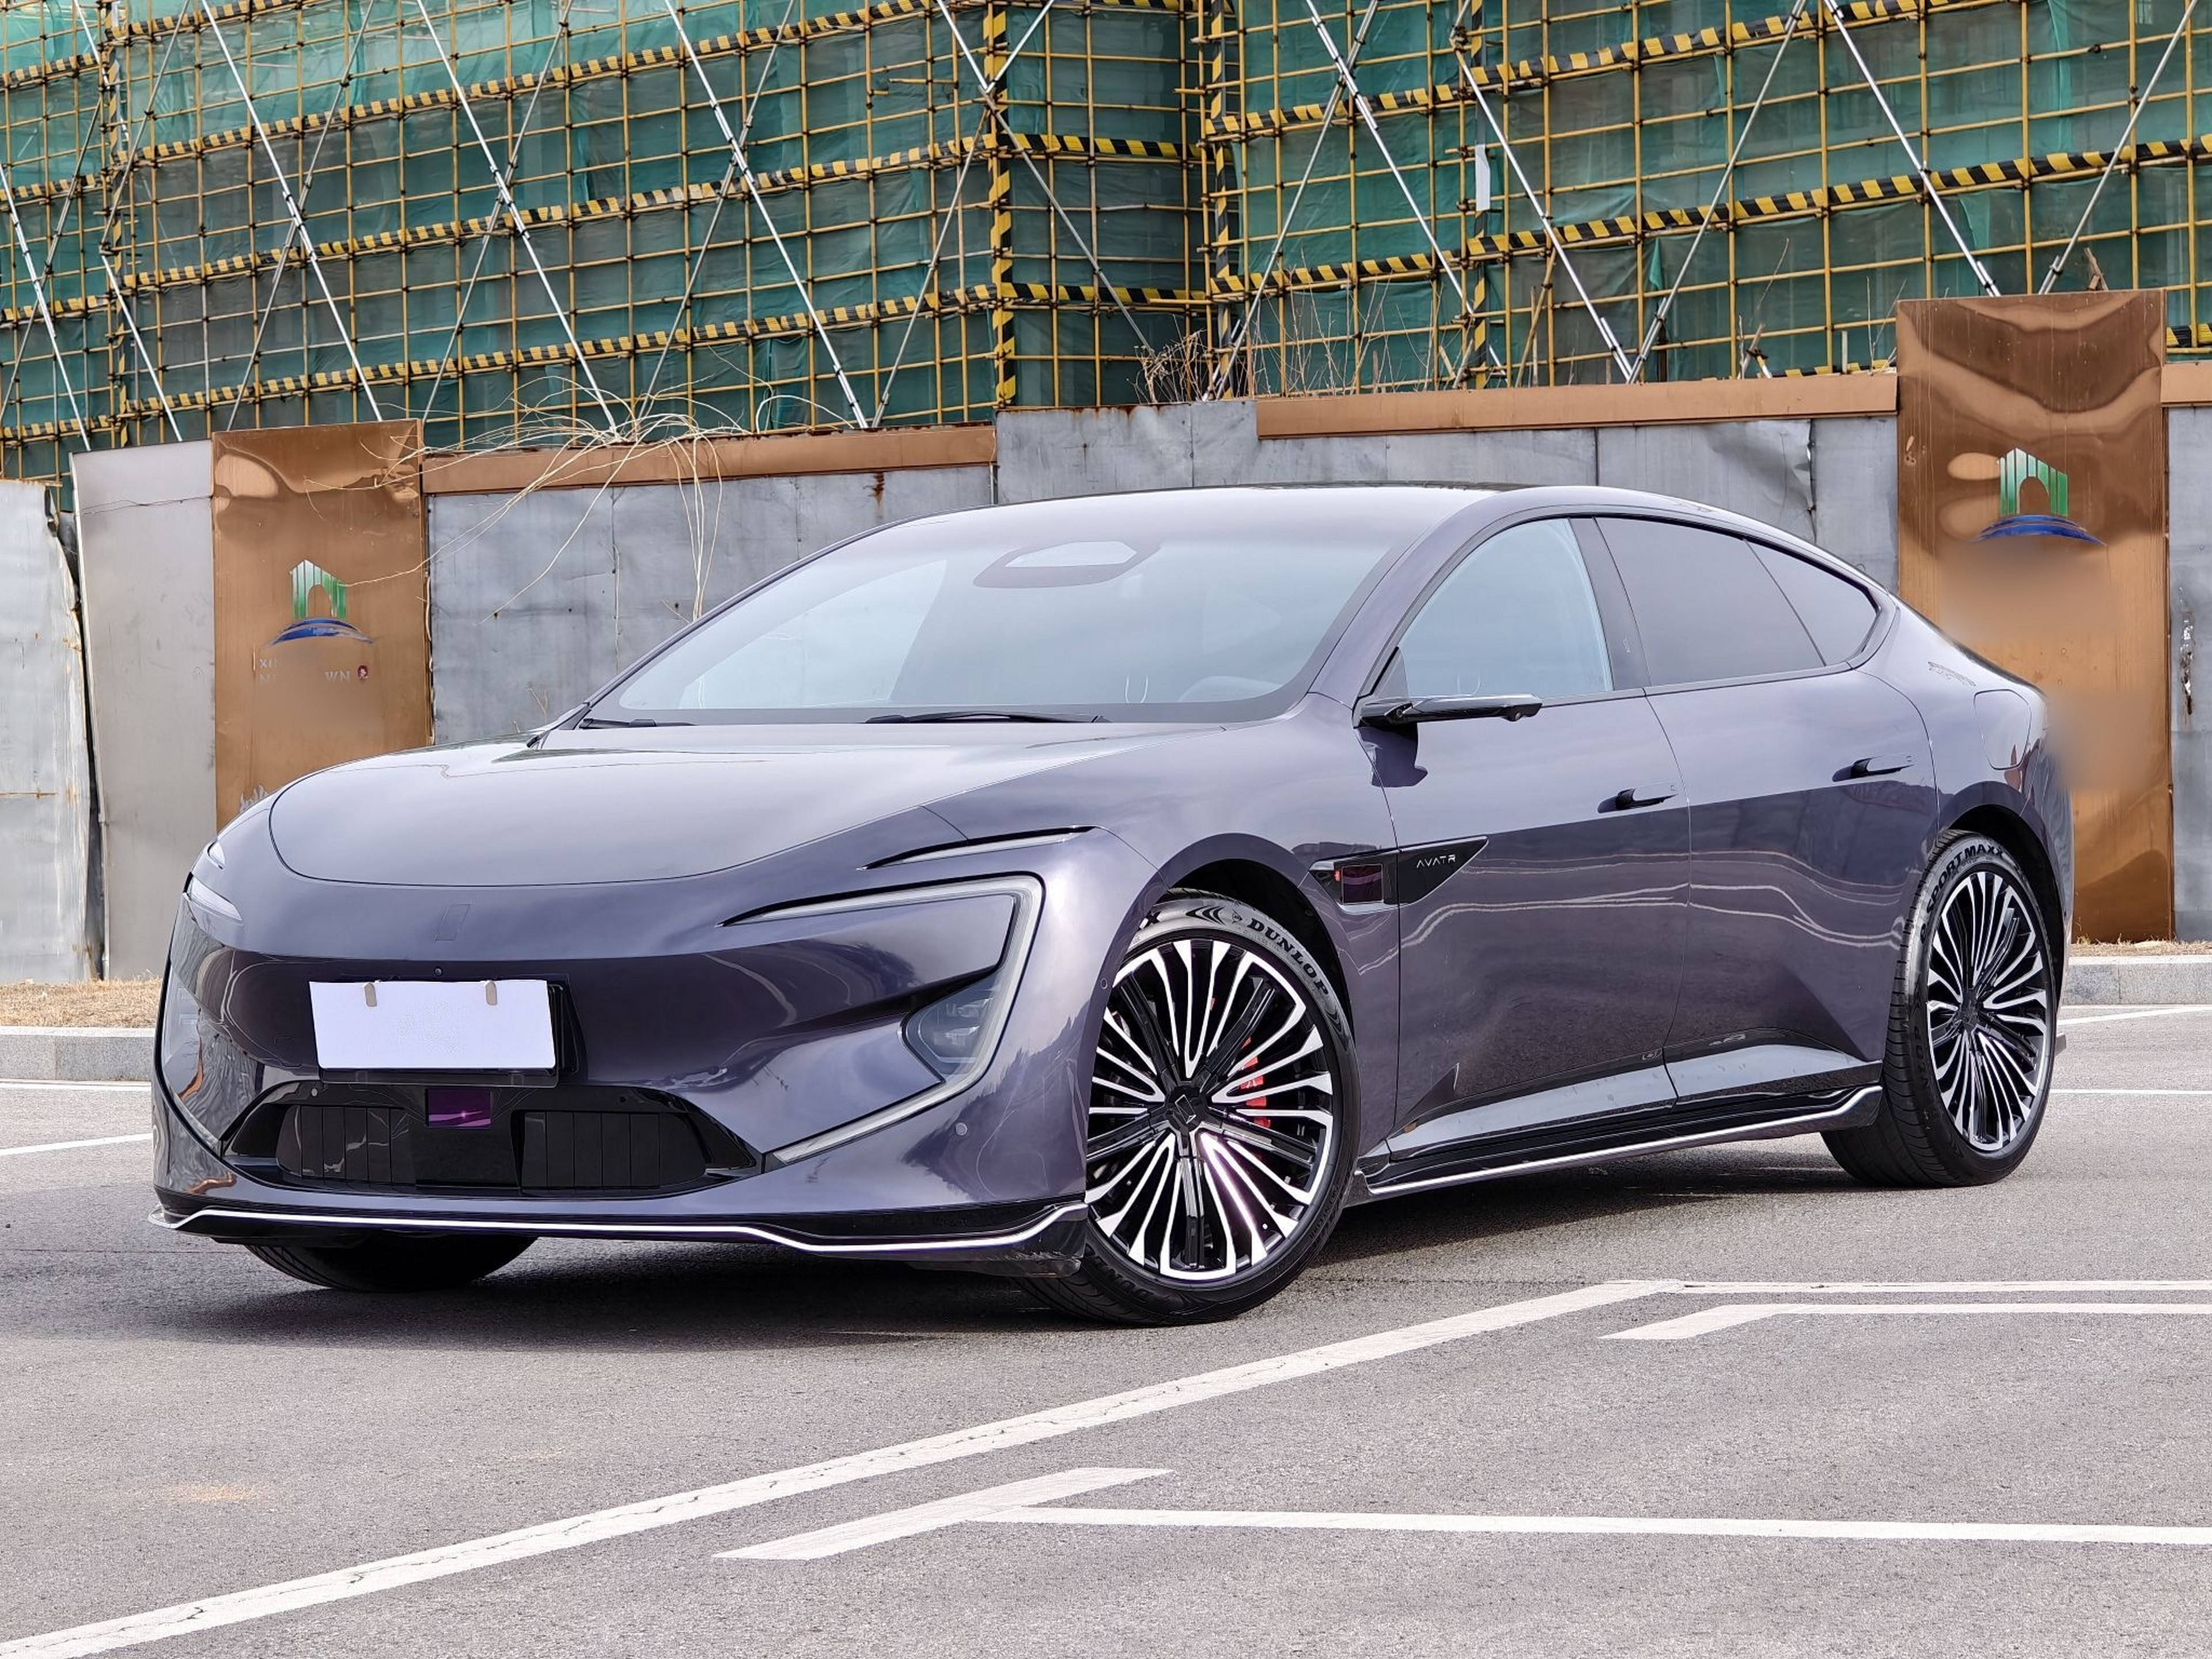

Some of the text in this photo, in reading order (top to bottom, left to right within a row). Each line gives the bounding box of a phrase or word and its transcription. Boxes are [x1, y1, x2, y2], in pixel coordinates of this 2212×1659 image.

[1416, 854, 1456, 869] AVATR
[1926, 843, 2003, 914] SPORT MAXX
[1247, 917, 1330, 995] DUNLOP
